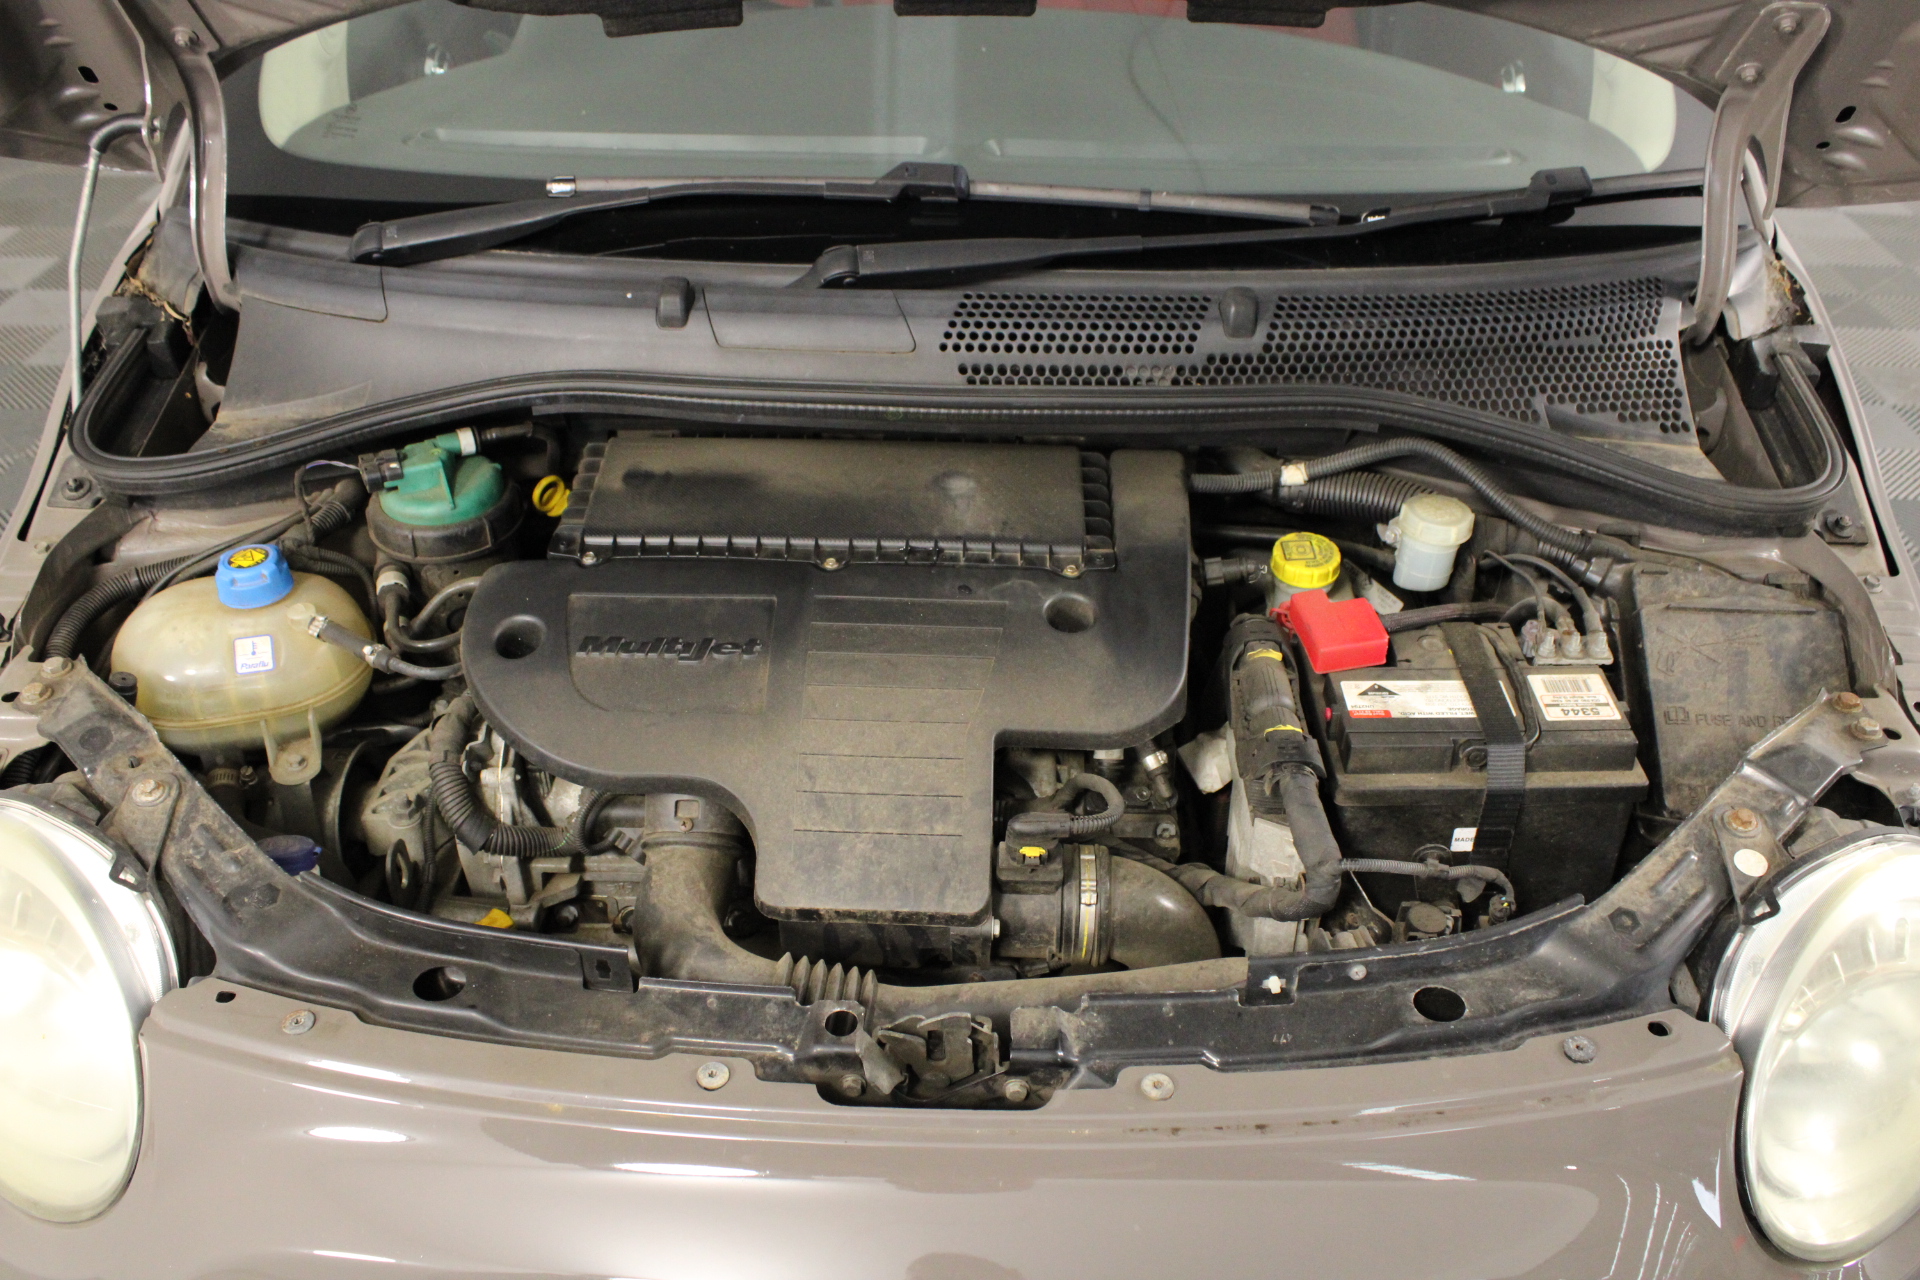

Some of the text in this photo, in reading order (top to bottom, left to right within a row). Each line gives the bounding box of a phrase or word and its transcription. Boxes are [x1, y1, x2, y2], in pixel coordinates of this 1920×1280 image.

[575, 635, 762, 665] MultiJet
[241, 661, 269, 670] Paraflu
[1560, 707, 1601, 716] 5344
[1694, 713, 1732, 726] FUSE
[1738, 715, 1767, 728] AND
